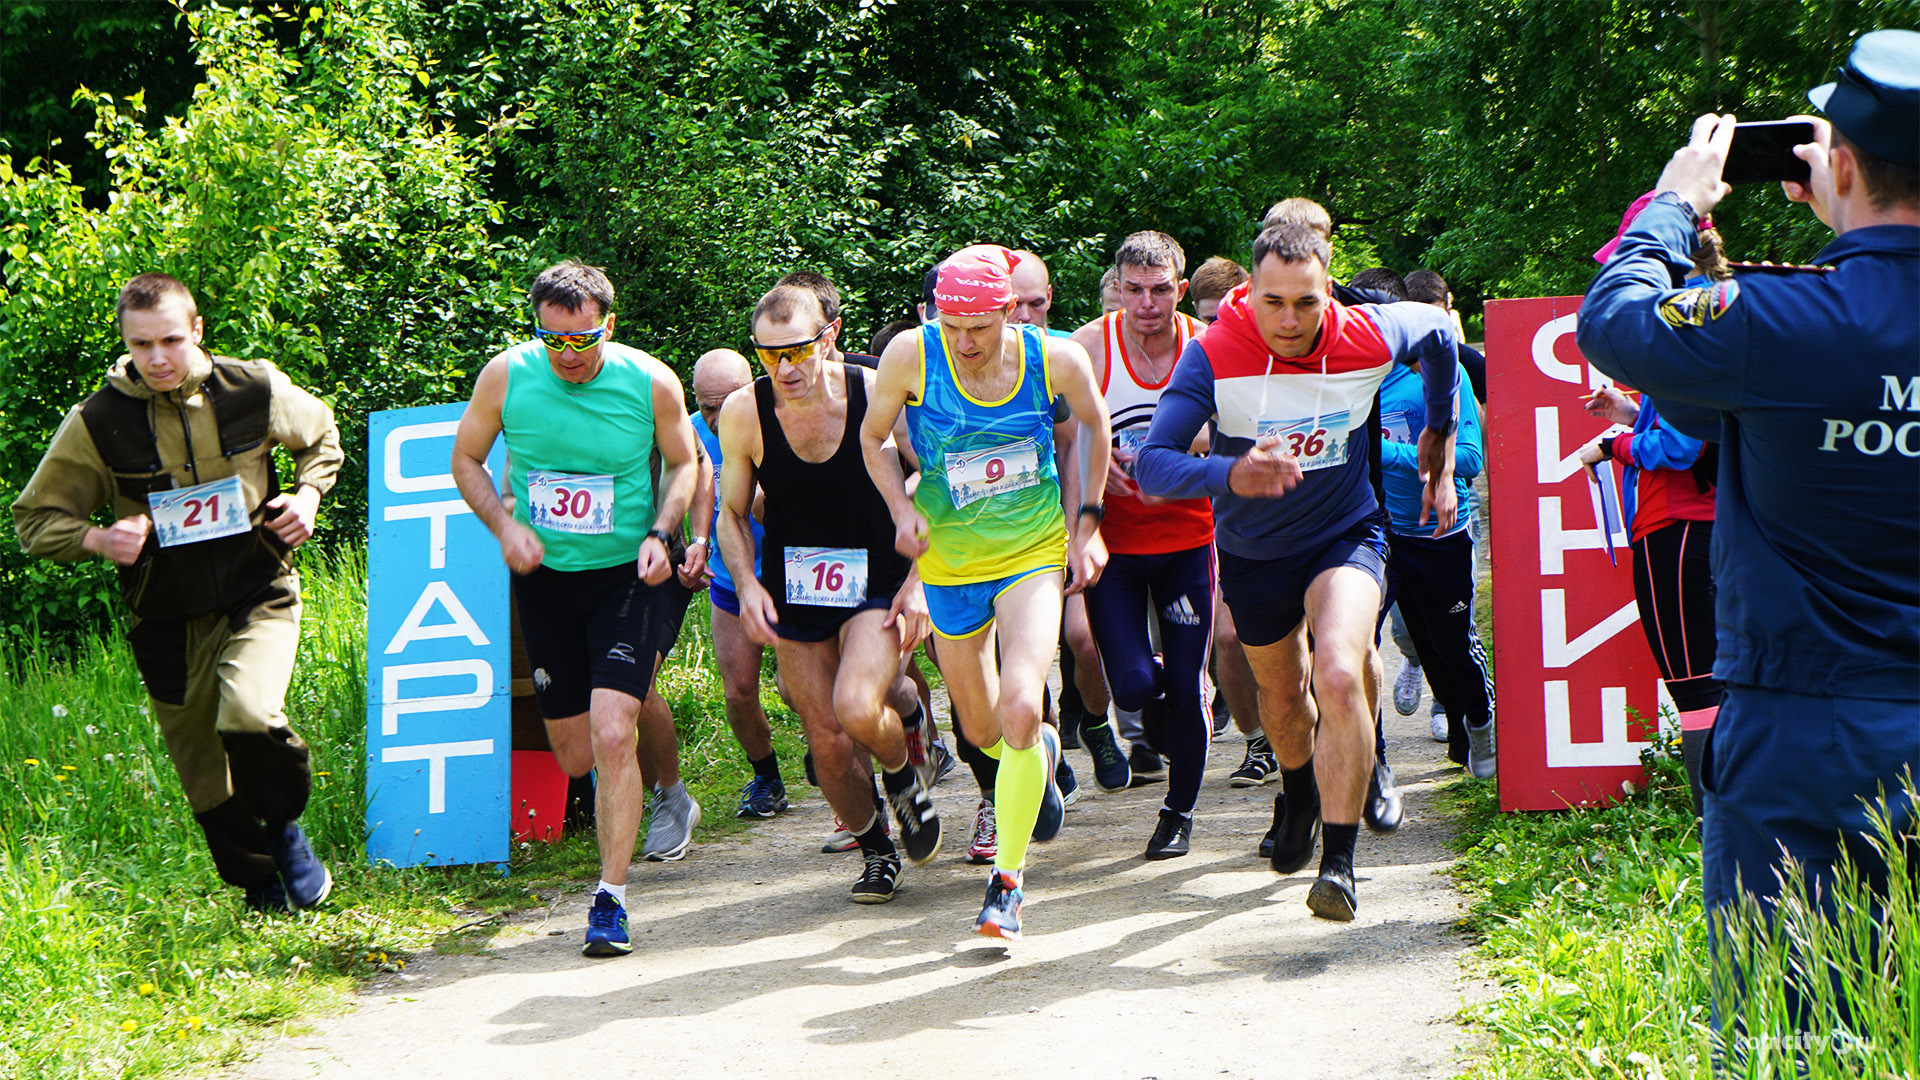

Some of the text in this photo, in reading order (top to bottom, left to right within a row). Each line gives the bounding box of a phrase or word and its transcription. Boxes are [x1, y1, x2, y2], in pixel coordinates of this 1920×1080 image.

[1287, 429, 1327, 458] 36
[984, 458, 1005, 484] 9
[183, 494, 220, 528] 21
[550, 487, 591, 519] 30
[811, 562, 846, 592] 16
[382, 420, 494, 814] СТАРТ
